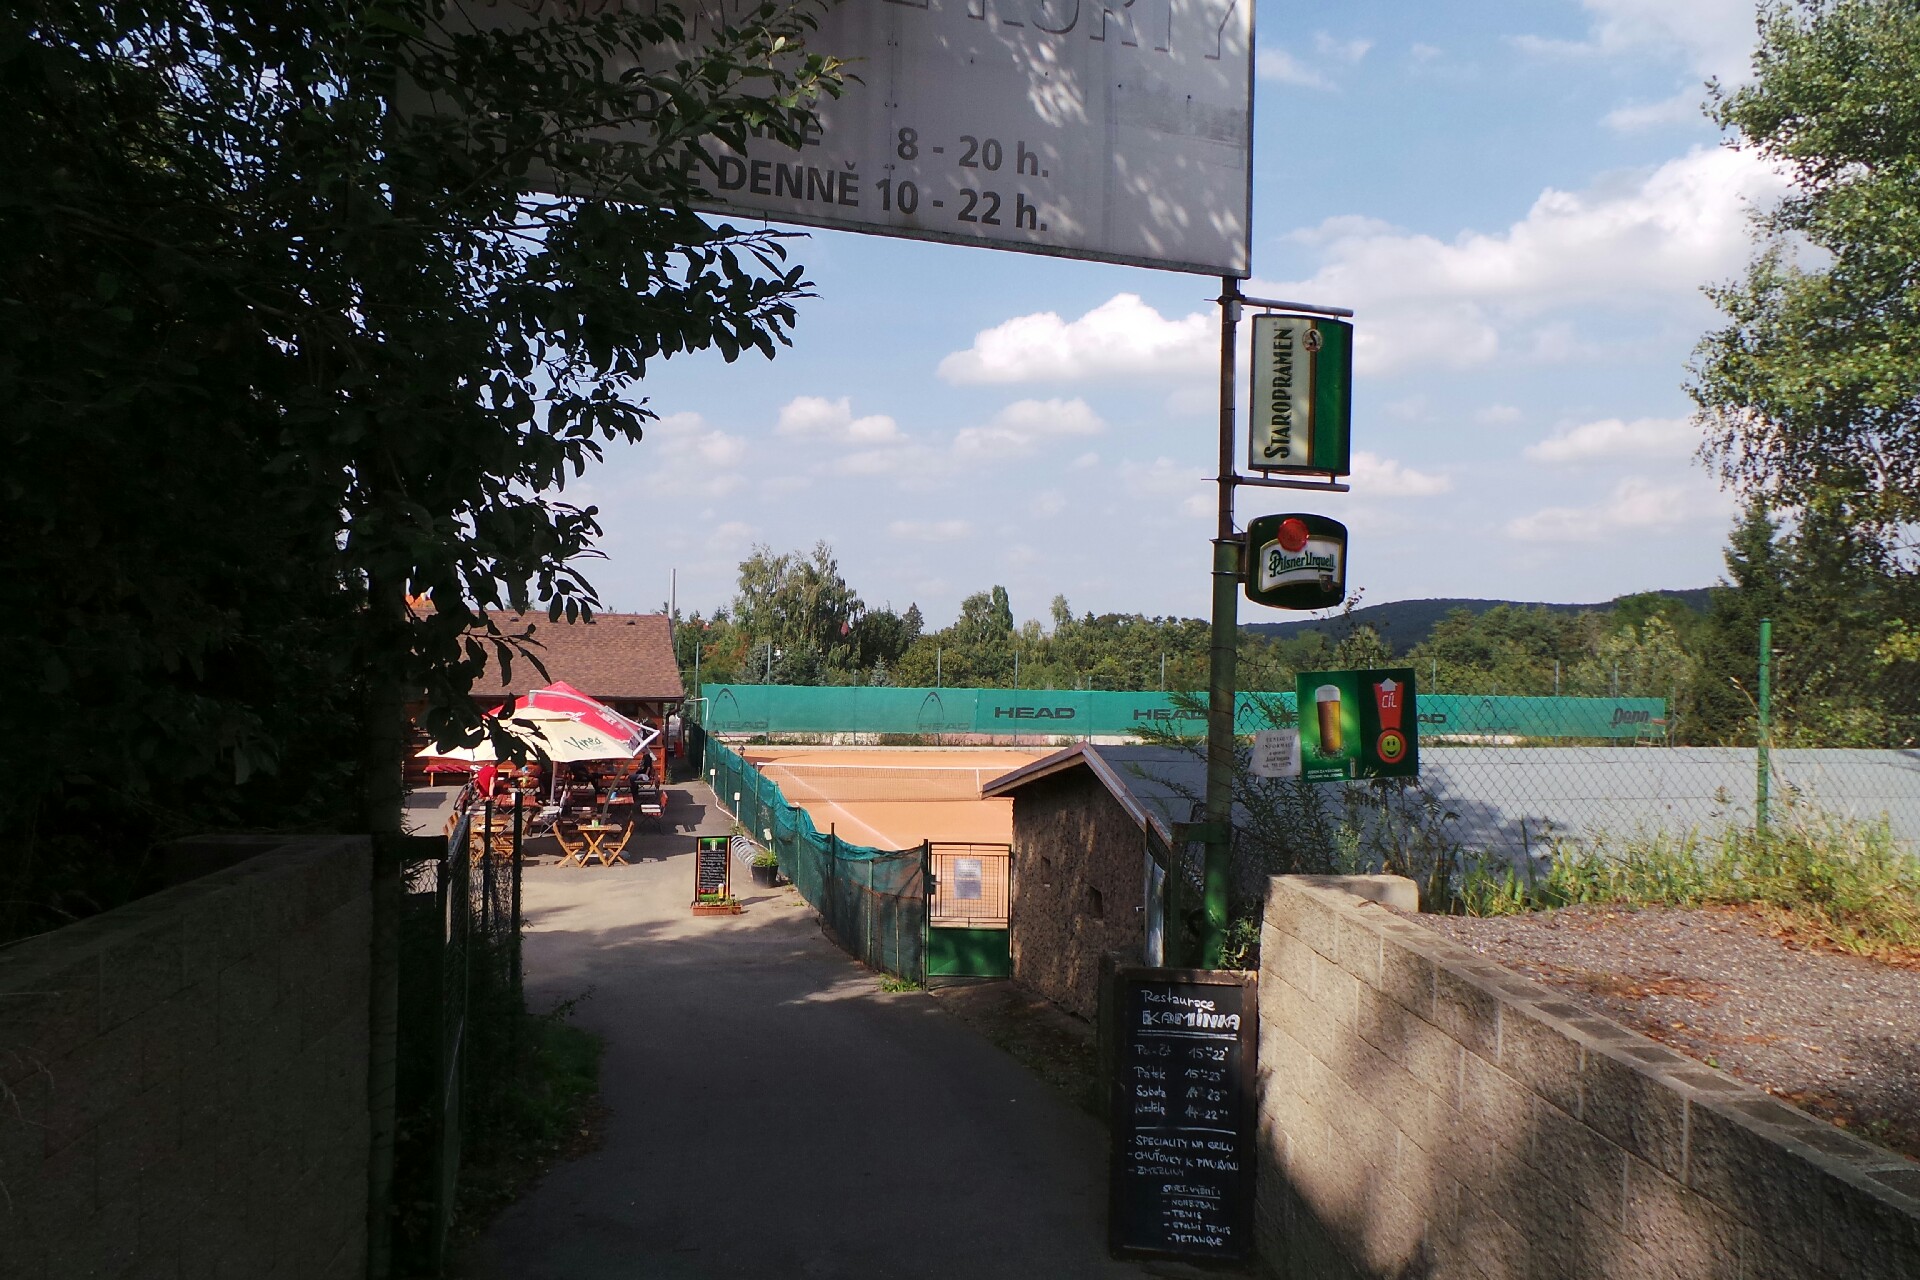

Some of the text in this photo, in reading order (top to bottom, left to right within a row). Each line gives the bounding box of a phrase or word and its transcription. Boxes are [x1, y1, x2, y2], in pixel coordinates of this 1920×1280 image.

[897, 127, 919, 160] 8
[958, 135, 1002, 171] 20
[1016, 141, 1049, 178] h.
[718, 155, 859, 207] DENNĚ
[876, 179, 919, 214] 10
[958, 188, 1001, 225] 22
[1016, 193, 1048, 231] h.
[1269, 550, 1335, 577] Pilsner Urquell
[995, 707, 1075, 719] HEAD
[1418, 713, 1446, 724] AD
[1140, 987, 1215, 1011] Restaurace
[1133, 1065, 1166, 1080] Pátek
[1136, 1135, 1187, 1148] SPECIALITY
[1191, 1140, 1204, 1149] NA
[1185, 1159, 1193, 1167] K
[1171, 1209, 1202, 1220] TENIS
[1205, 1224, 1231, 1235] TENIS
[1171, 1233, 1223, 1247] PETANQUE
